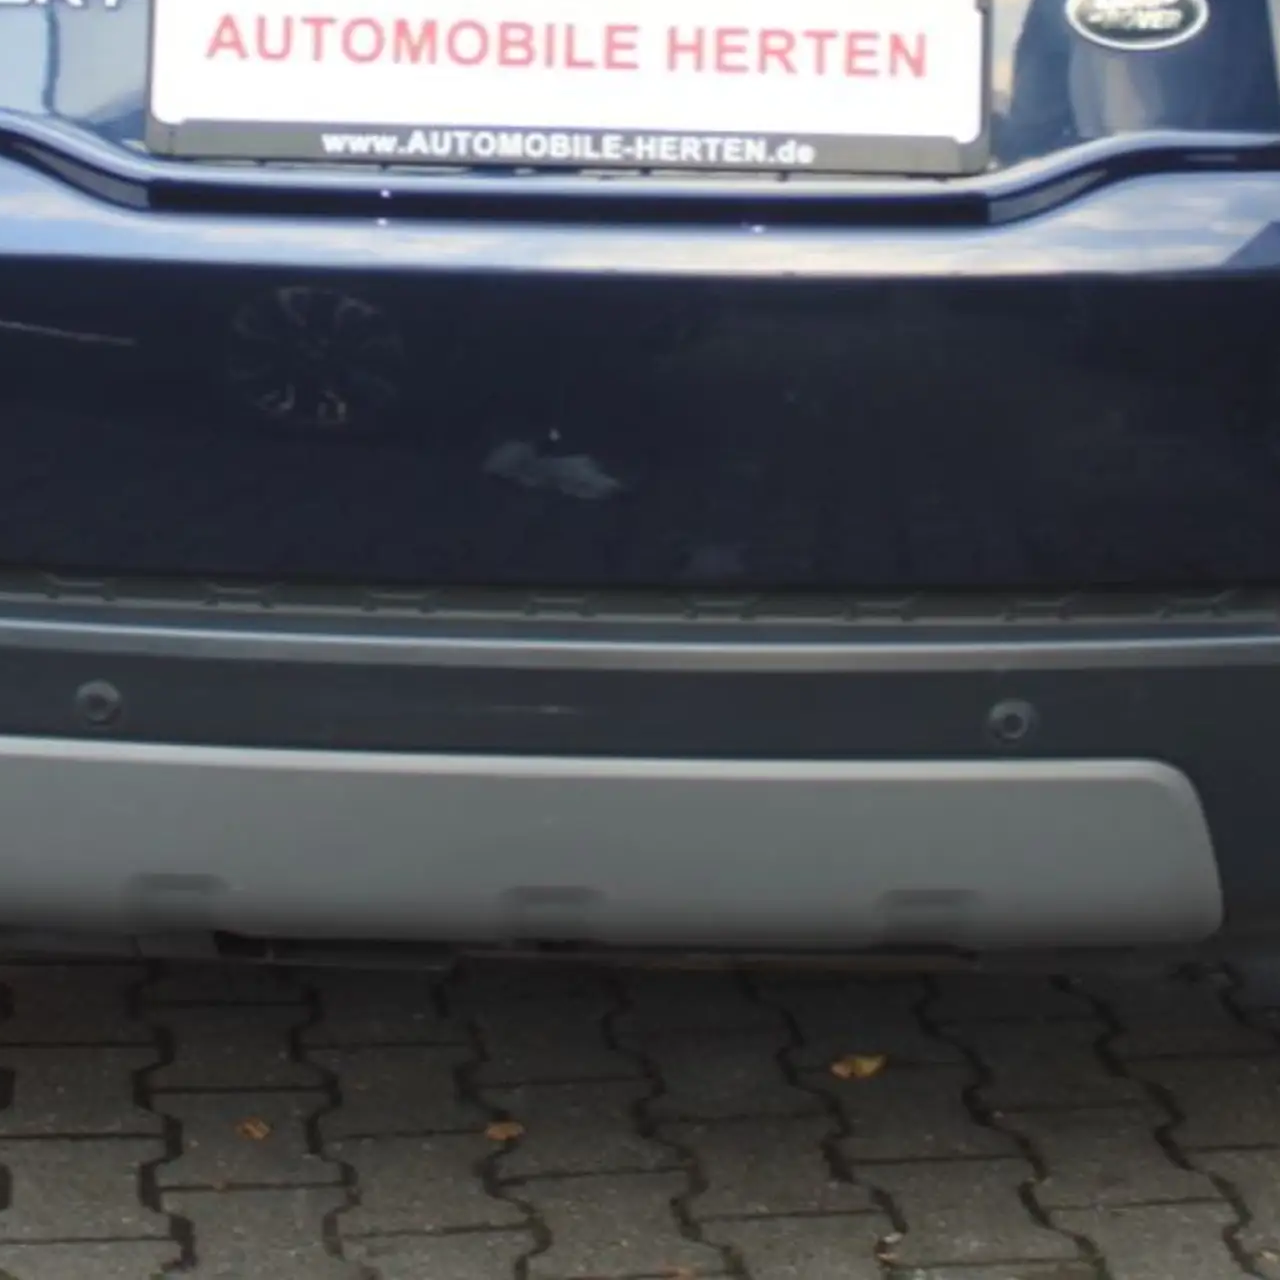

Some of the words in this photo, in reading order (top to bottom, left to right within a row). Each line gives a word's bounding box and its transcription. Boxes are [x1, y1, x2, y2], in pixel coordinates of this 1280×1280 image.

[206, 14, 639, 70] AUTOMOBILE
[667, 27, 928, 78] HERTEN
[323, 128, 815, 165] www.AUTOMOBILE-HERTEN.de
